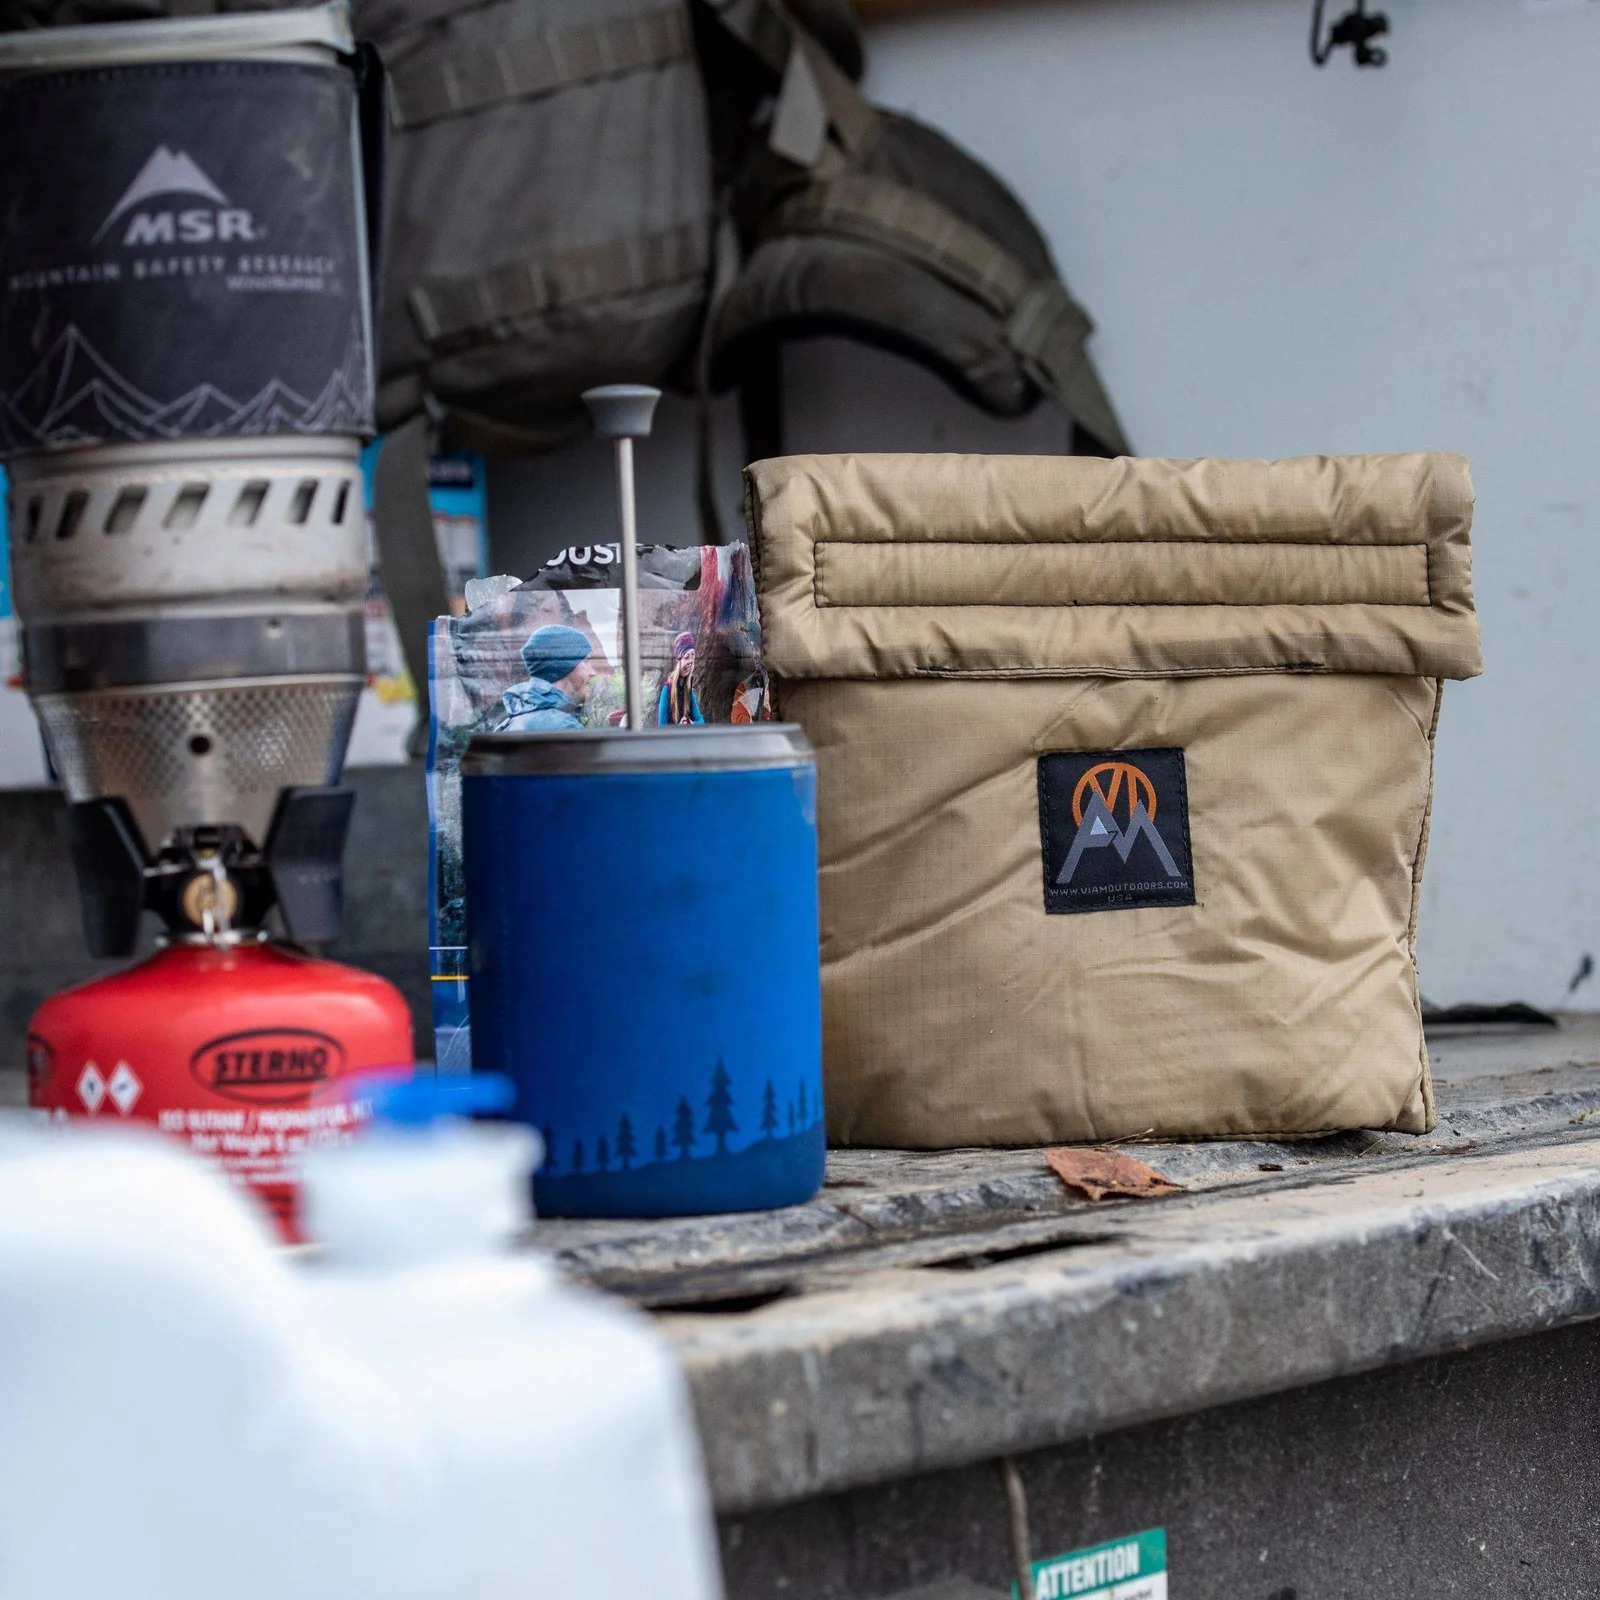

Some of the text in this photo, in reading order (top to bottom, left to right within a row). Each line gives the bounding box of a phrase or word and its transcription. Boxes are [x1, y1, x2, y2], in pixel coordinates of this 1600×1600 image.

[123, 208, 254, 246] MSR
[132, 255, 226, 280] SAFETY
[213, 1048, 328, 1082] STERNO
[1036, 1541, 1140, 1600] ATTENTION
